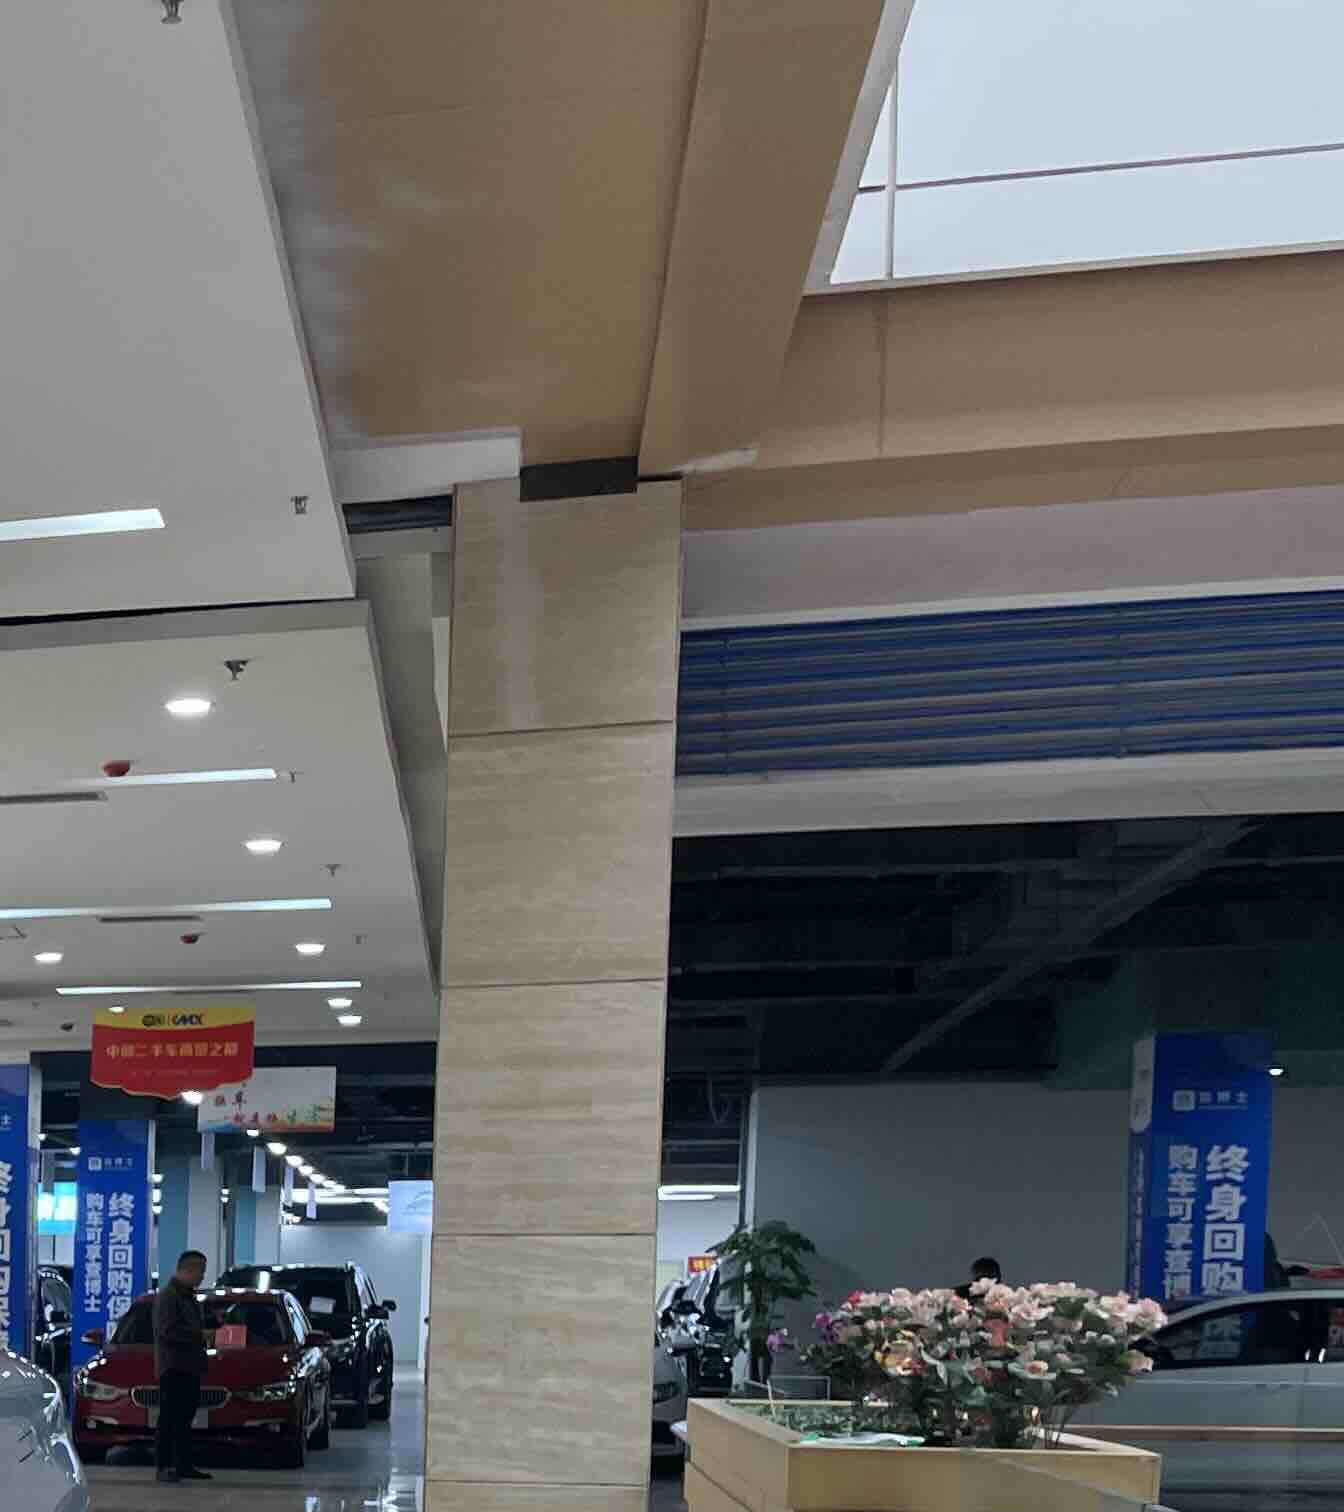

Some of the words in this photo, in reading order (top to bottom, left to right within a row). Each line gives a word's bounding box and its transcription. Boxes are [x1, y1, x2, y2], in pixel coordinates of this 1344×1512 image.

[85, 1192, 104, 1313] 购车可享查博士
